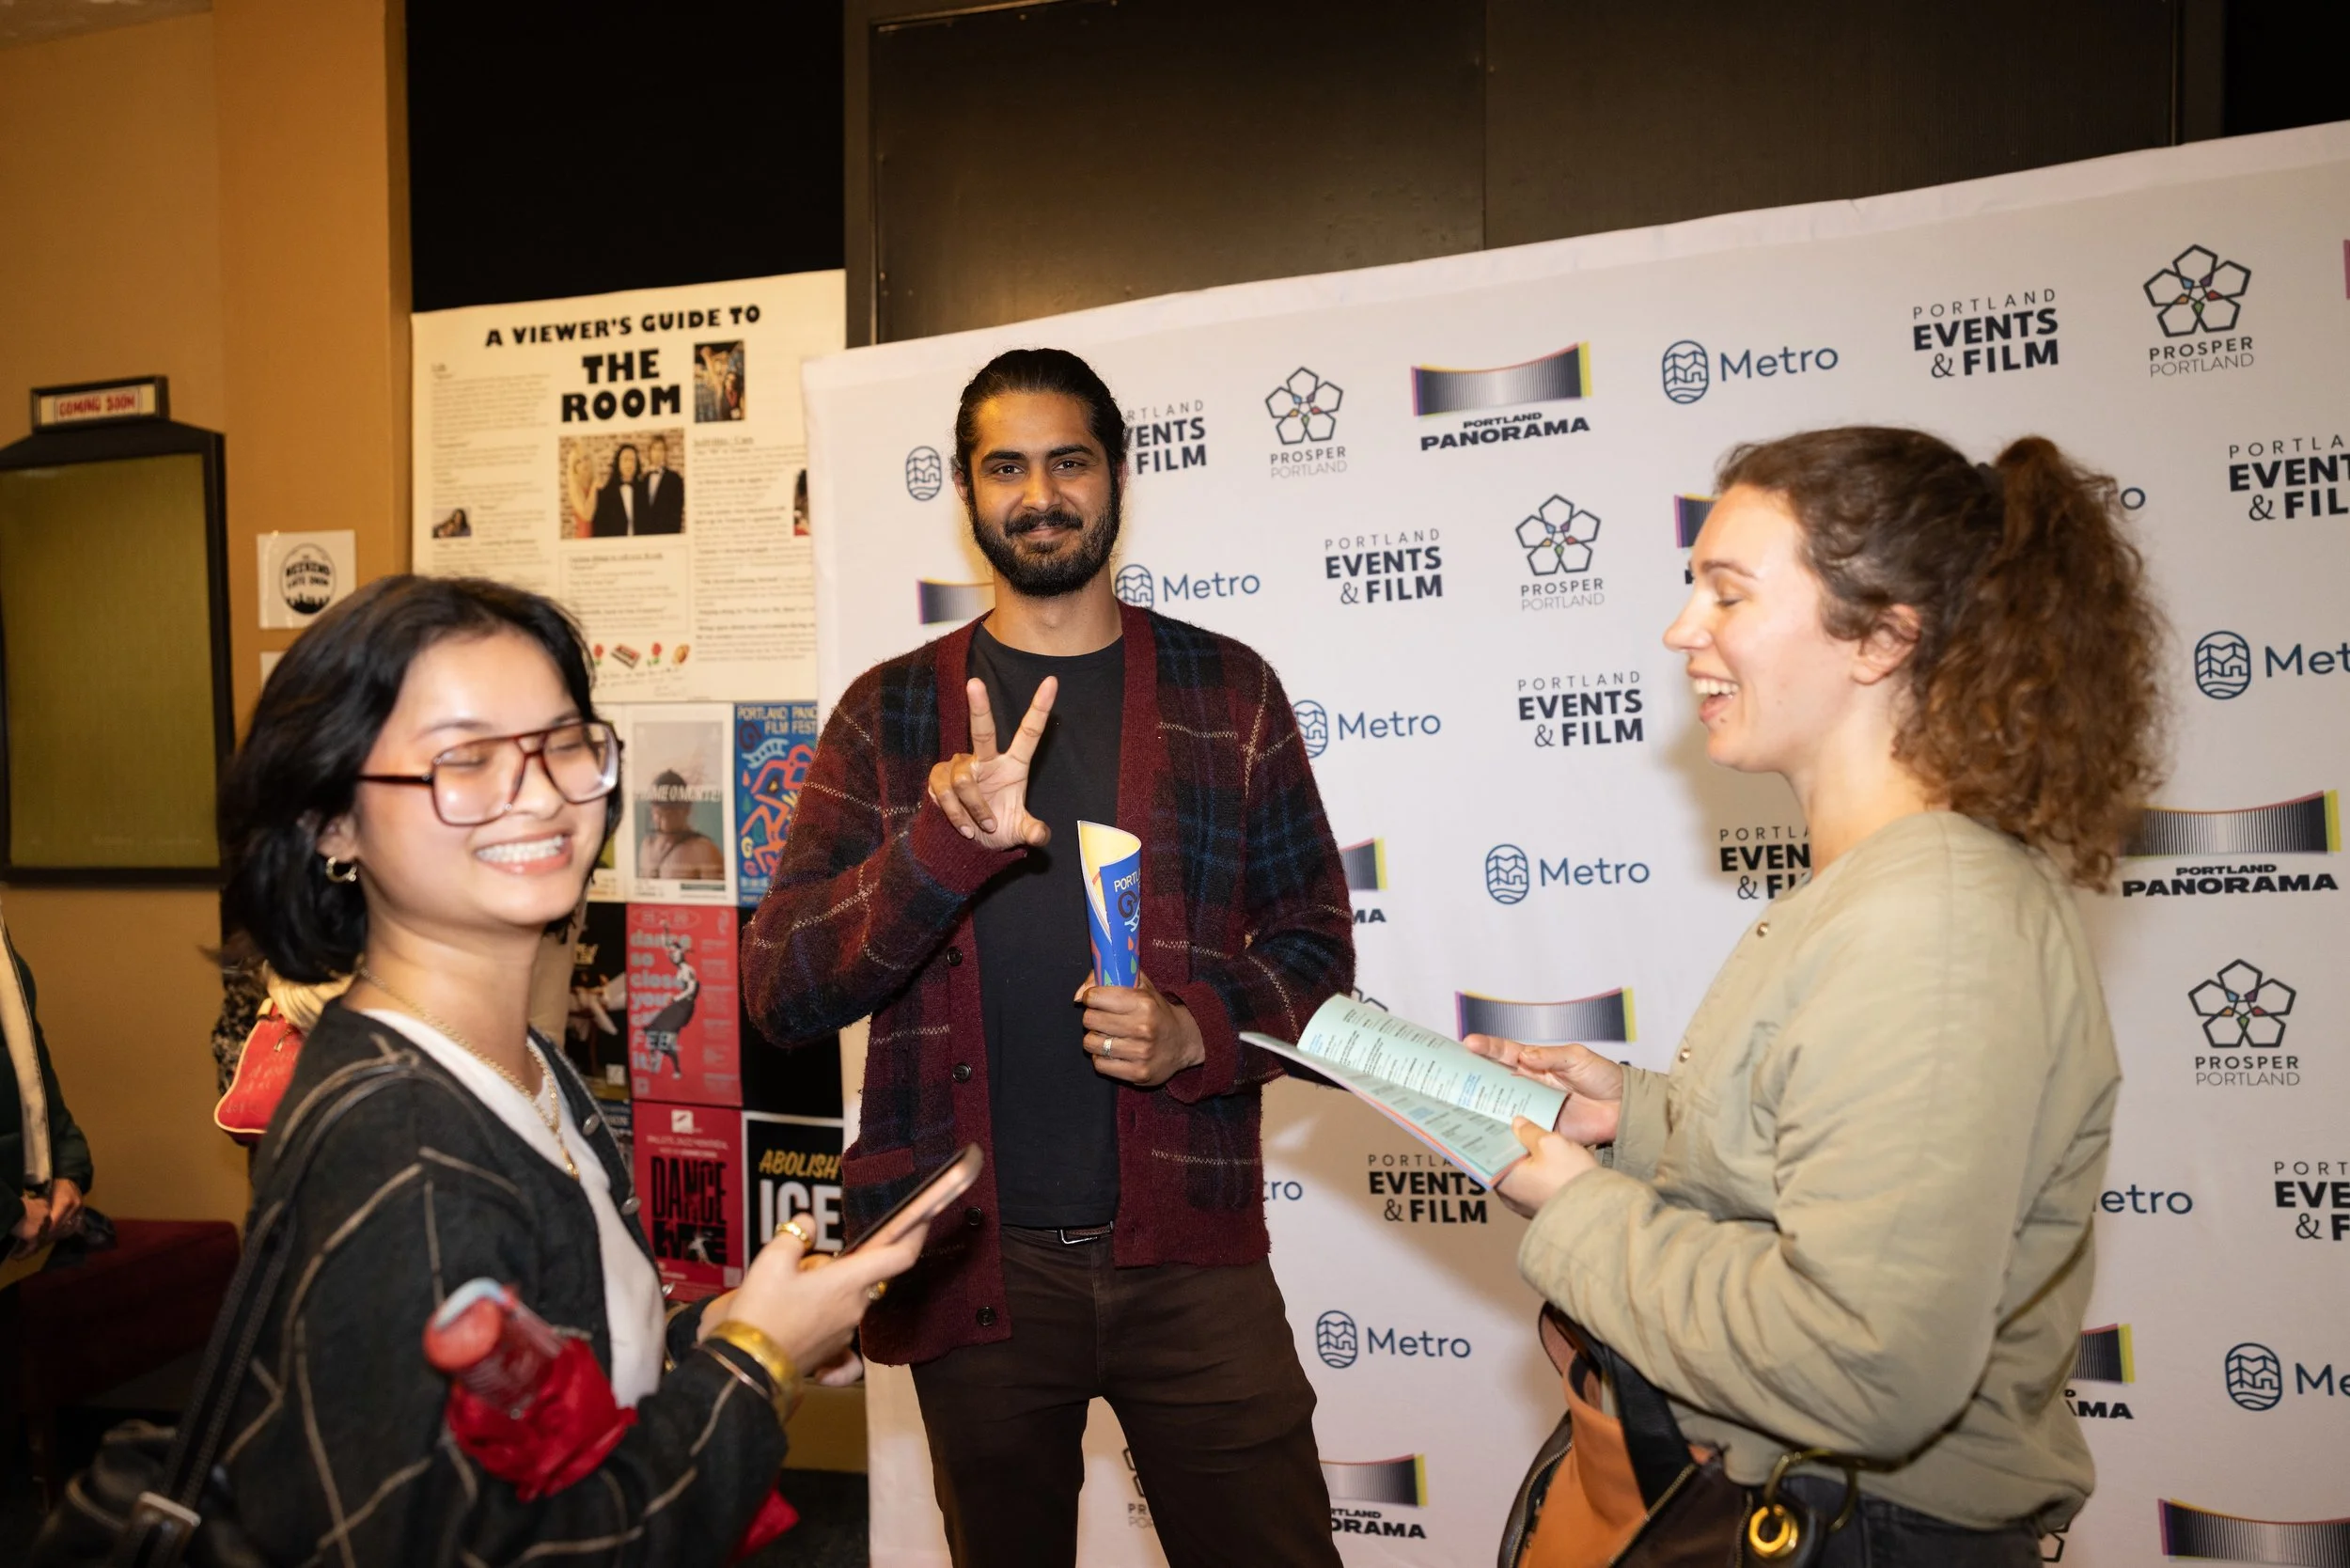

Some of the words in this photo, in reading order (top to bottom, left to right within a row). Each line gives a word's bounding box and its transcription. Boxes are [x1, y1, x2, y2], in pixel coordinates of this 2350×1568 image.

[1913, 289, 2056, 320] PORTLAND
[485, 329, 503, 347] A
[512, 314, 632, 345] VIEWER'S
[641, 308, 721, 333] GUIDE
[730, 305, 761, 325] TO
[1913, 307, 2059, 351] EVENTS
[1930, 353, 1956, 379] &
[1963, 339, 2059, 376] FILM
[2150, 337, 2253, 362] PROSPER
[582, 349, 660, 384] THE
[1719, 346, 1839, 382] Metro
[2150, 353, 2254, 378] PORTLAND
[59, 396, 102, 417] COMING
[106, 393, 136, 412] SOON
[562, 384, 681, 423] ROOM
[1420, 416, 1591, 451] PANORAMA
[1464, 412, 1542, 429] PORTLAND
[1136, 444, 1207, 475] FILM
[1271, 447, 1346, 465] PROSPER
[2229, 434, 2344, 460] PORTLA
[1271, 460, 1348, 478] PORTLAND
[2248, 494, 2276, 521] &
[2284, 487, 2350, 519] FIL
[1324, 528, 1440, 551] PORTLAND
[1326, 546, 1442, 579] EVENTS
[1162, 572, 1261, 603] Metro
[1340, 582, 1360, 604] &
[1367, 573, 1443, 604] FILM
[1521, 577, 1604, 596] PROSPER
[1521, 592, 1605, 612] PORTLAND
[1518, 670, 1640, 692] PORTLAND
[736, 706, 788, 721] PORTLAND
[1518, 689, 1642, 721] EVENTS
[764, 720, 789, 735] FILM
[1339, 712, 1441, 742] Metro
[1534, 724, 1556, 747] &
[1562, 718, 1643, 747] FILM
[1720, 843, 1811, 871] EVEN
[2175, 864, 2277, 876] PORTLAND
[1540, 857, 1650, 887] Metro
[2122, 873, 2339, 897] PANORAMA
[1737, 875, 1760, 900] &
[1766, 873, 1806, 900] FI
[2195, 1056, 2298, 1069] PROSPER
[2196, 1072, 2300, 1086] PORTLAND
[759, 1149, 842, 1180] ABOLISH
[2275, 1161, 2348, 1175] PORT
[650, 1155, 727, 1225] DANCE
[1369, 1171, 1487, 1196] EVENTS
[1384, 1199, 1403, 1222] &
[1410, 1200, 1487, 1223] FILM
[2092, 1184, 2193, 1215] etro
[760, 1178, 843, 1250] ICE
[2295, 1213, 2323, 1239] &
[1367, 1327, 1471, 1358] Metro
